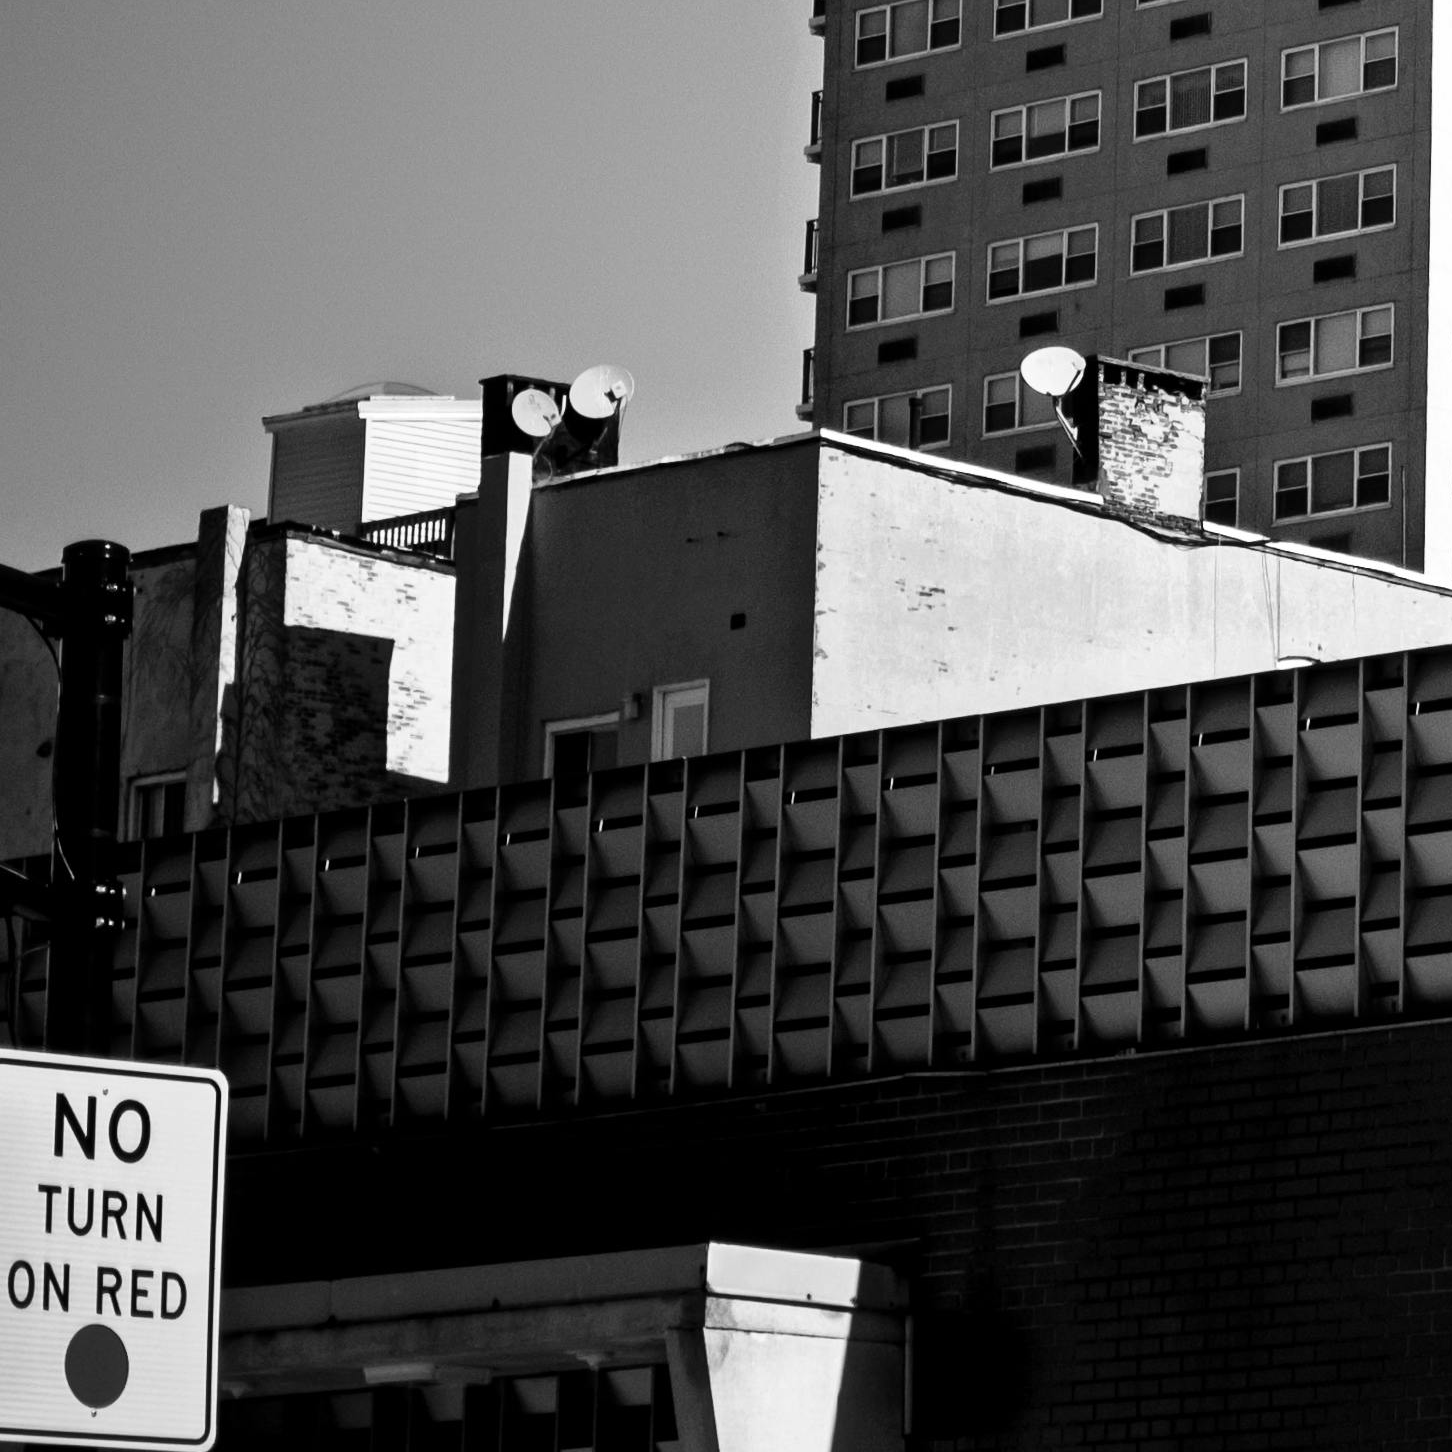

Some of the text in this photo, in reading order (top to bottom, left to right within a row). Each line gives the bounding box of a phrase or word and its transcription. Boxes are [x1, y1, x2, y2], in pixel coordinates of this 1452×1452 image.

[53, 1092, 151, 1164] NO
[38, 1183, 163, 1243] TURN
[7, 1259, 187, 1320] ON RED
